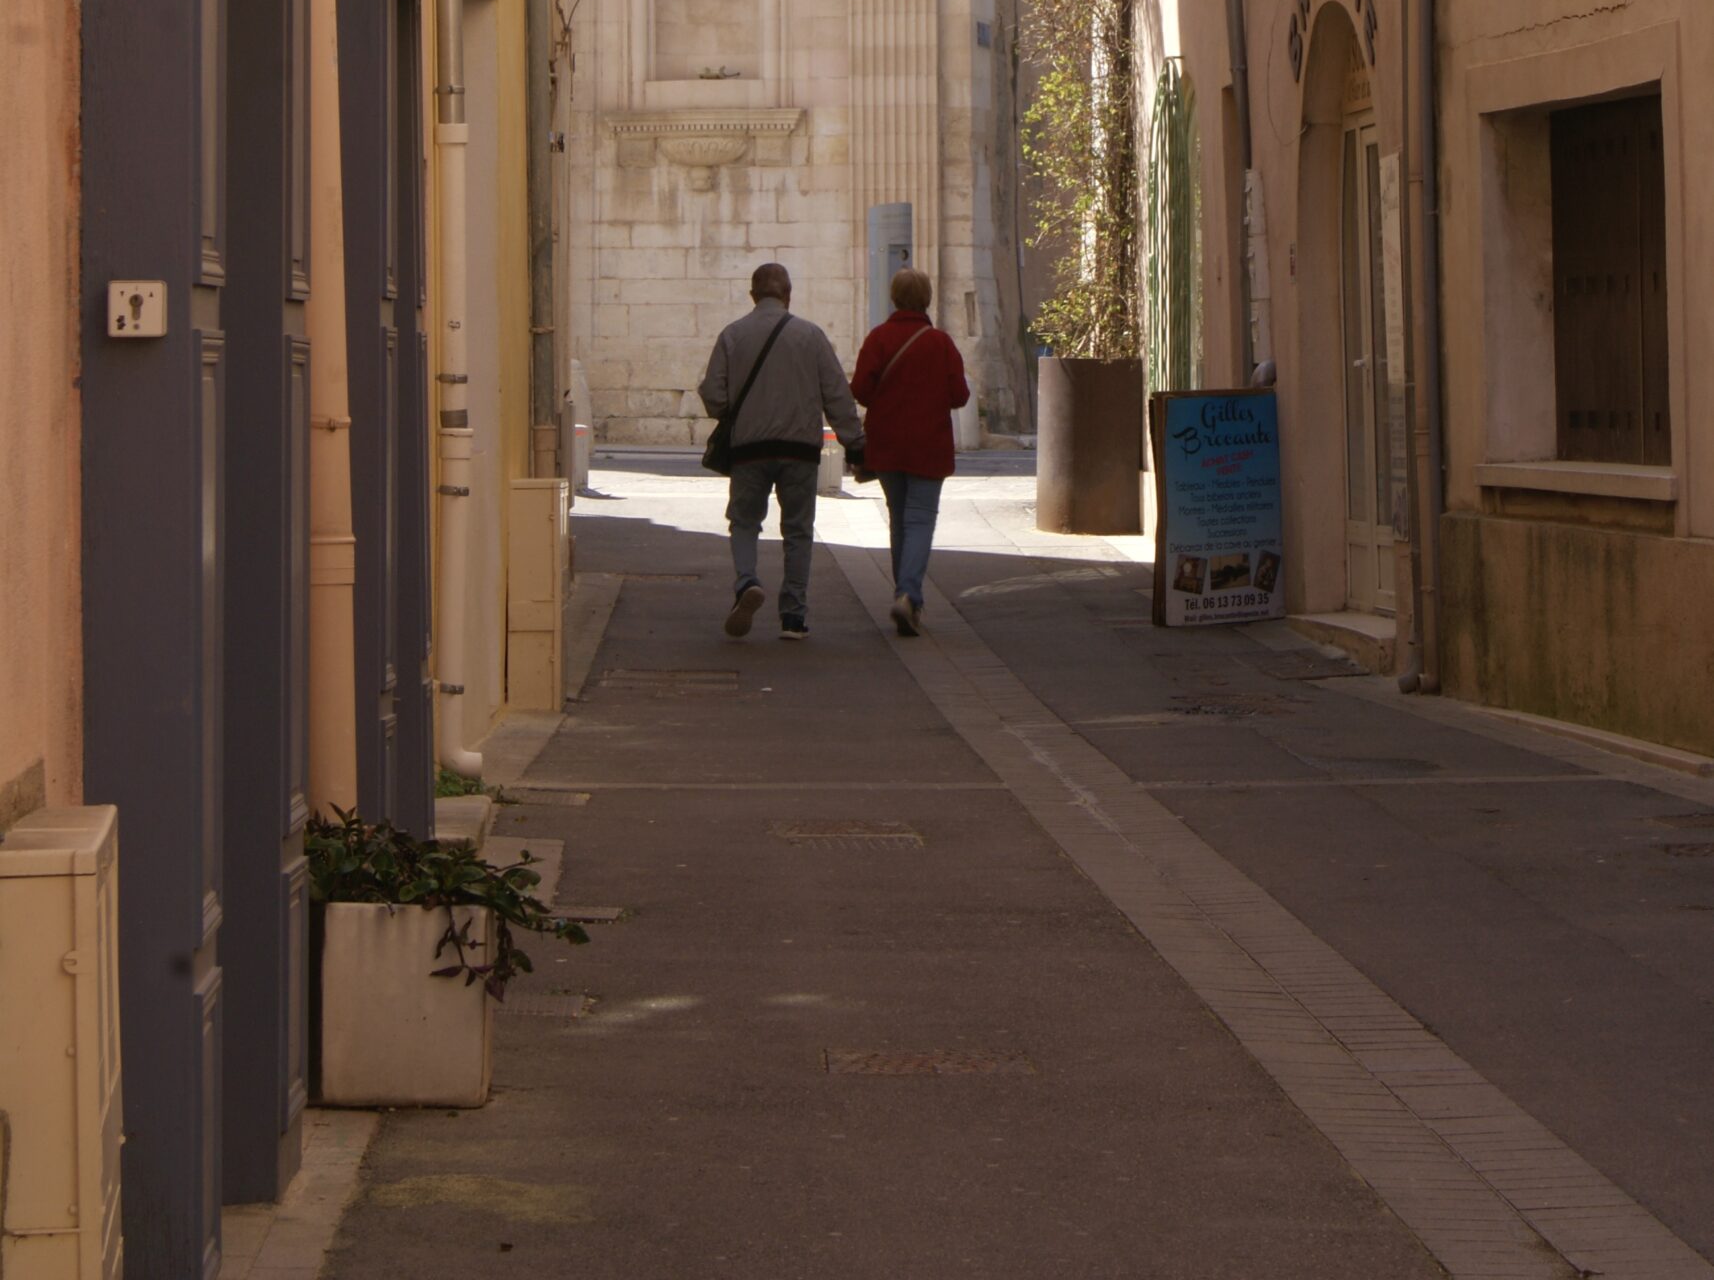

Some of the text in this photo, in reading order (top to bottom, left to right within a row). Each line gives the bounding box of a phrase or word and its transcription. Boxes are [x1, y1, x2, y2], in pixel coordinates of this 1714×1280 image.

[1201, 400, 1253, 434] Gilles
[1173, 420, 1272, 461] Brocante
[1185, 592, 1270, 610] Tél. 06 13 73 09 35
